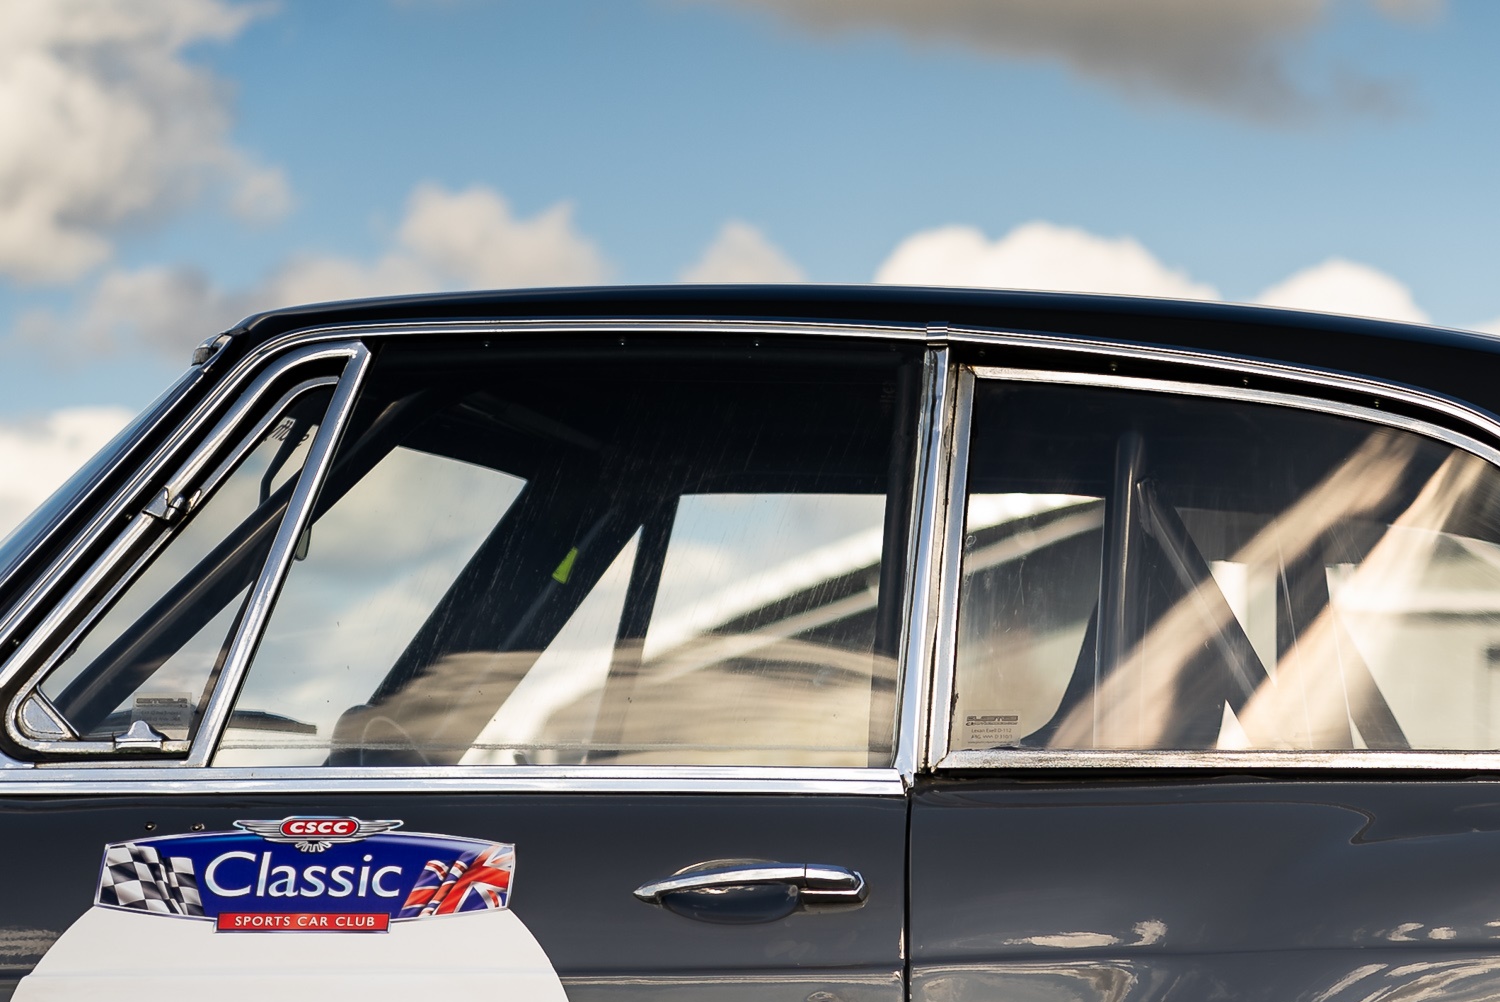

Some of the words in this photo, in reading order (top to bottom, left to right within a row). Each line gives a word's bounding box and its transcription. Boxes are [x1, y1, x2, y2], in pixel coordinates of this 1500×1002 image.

[289, 821, 349, 834] CSCC
[204, 850, 402, 898] Classic
[234, 915, 291, 927] SPORTS
[297, 914, 329, 927] CAR
[334, 914, 375, 927] CLUB
